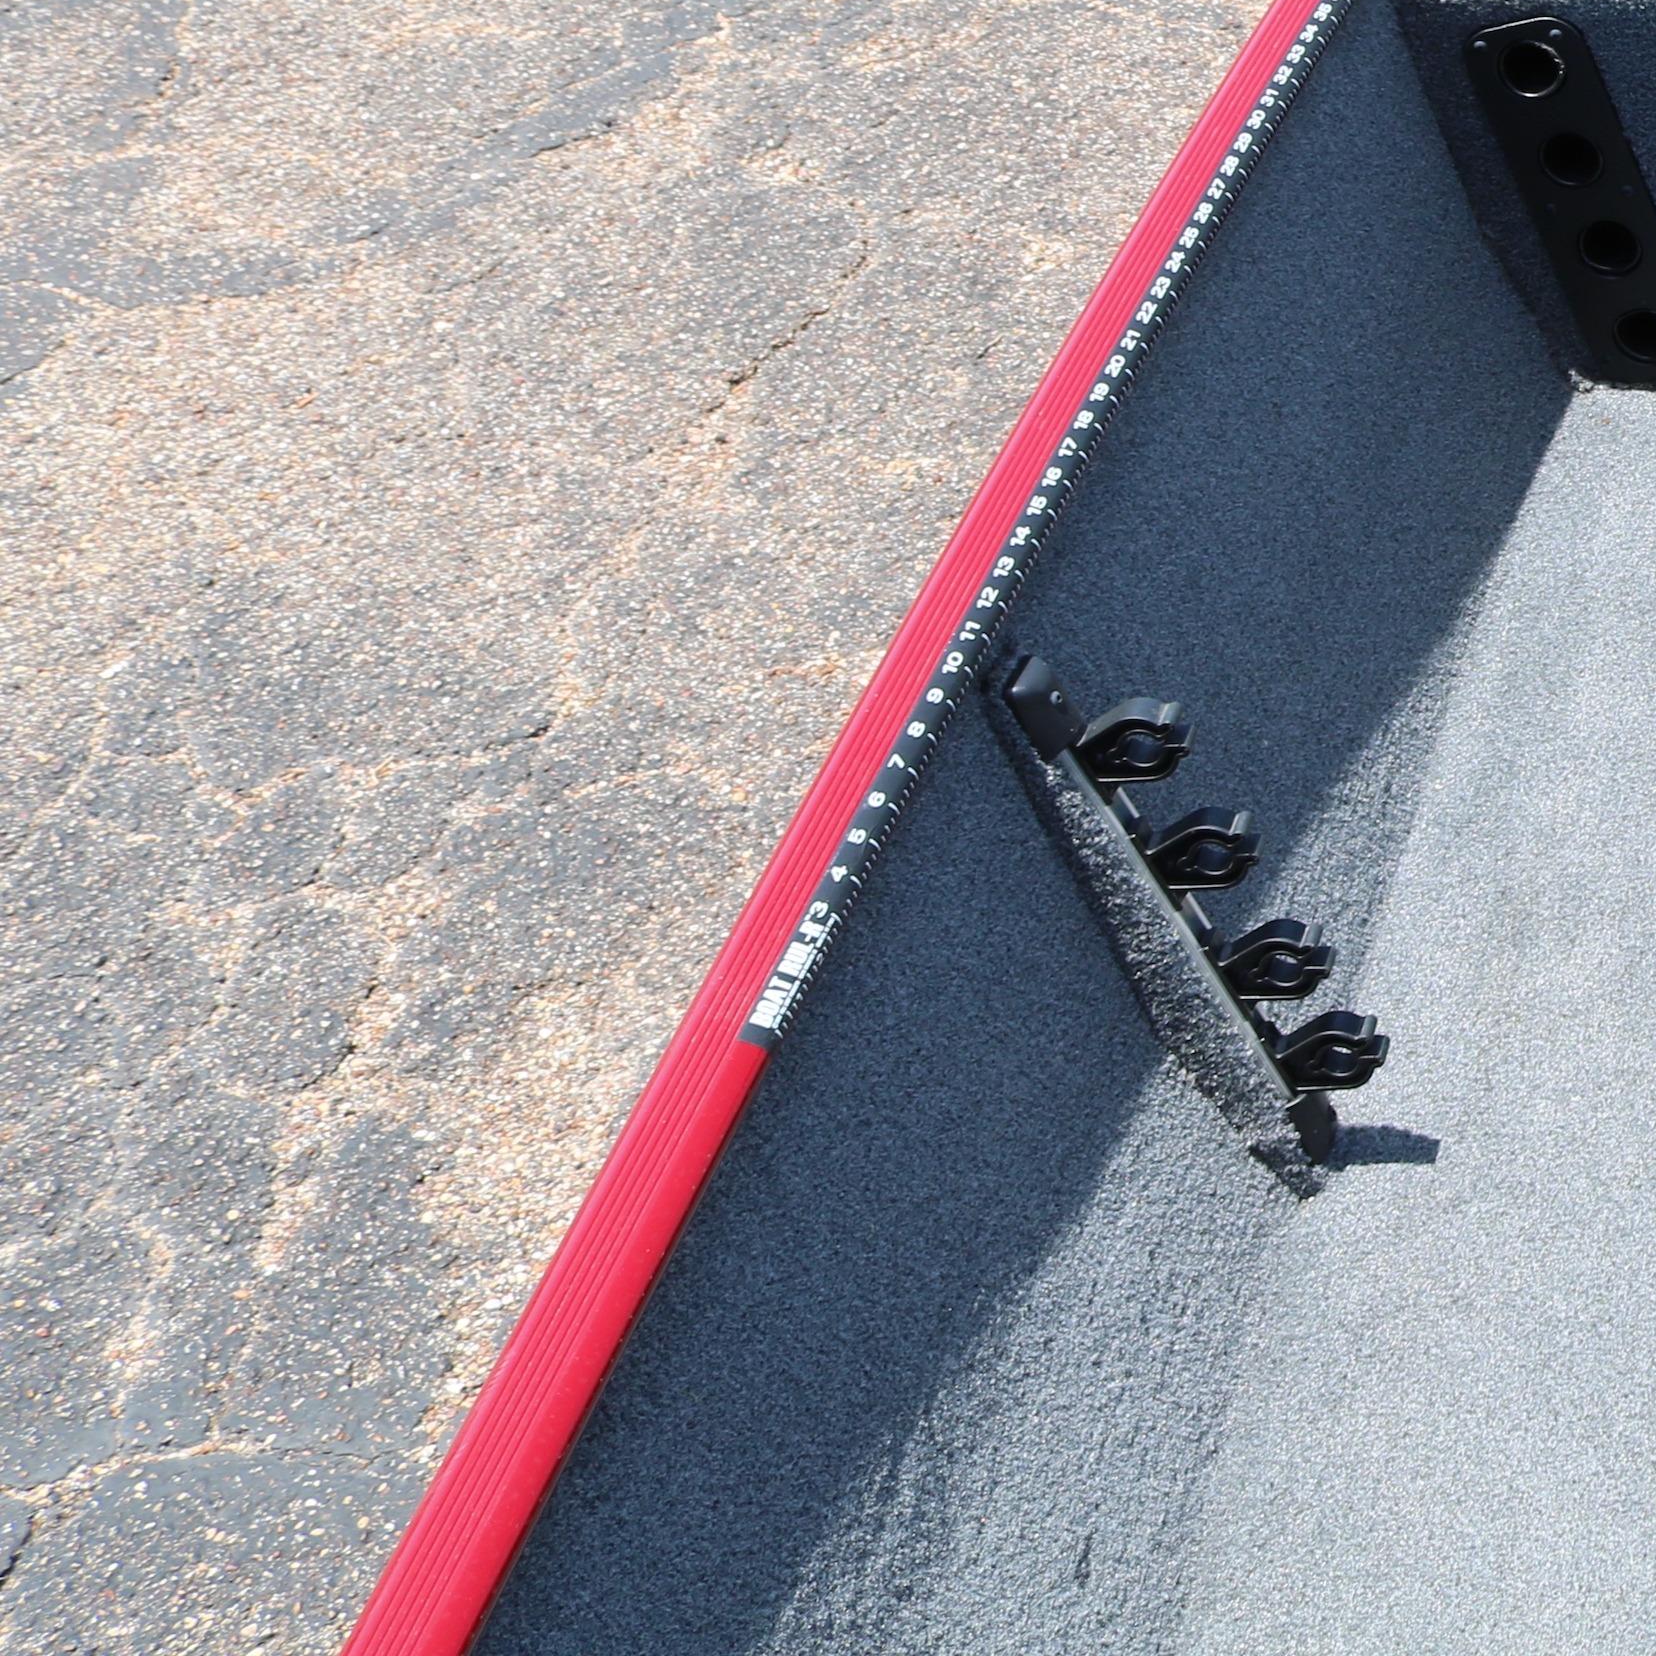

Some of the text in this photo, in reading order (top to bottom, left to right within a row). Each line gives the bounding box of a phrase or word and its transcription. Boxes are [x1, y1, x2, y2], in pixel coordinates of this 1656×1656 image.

[809, 901, 828, 918] 3
[830, 865, 848, 882] 4
[848, 828, 866, 844] 5
[868, 791, 886, 808] 6
[887, 753, 905, 768] 7
[907, 721, 925, 737] 8
[926, 688, 944, 705] 9
[942, 651, 963, 673] 10
[959, 621, 981, 641] 11
[976, 586, 999, 608] 12
[993, 556, 1014, 577] 13
[1009, 526, 1031, 546] 14
[1026, 495, 1047, 515] 15
[1041, 467, 1062, 487] 16
[1058, 437, 1077, 457] 17
[1073, 410, 1094, 429] 18
[1089, 383, 1109, 401] 19
[1104, 354, 1125, 377] 20
[1120, 329, 1141, 351] 21
[1136, 301, 1155, 323] 22
[1150, 276, 1170, 299] 23
[1164, 251, 1185, 273] 24
[1178, 226, 1199, 248] 25
[1193, 202, 1213, 224] 26
[1206, 178, 1225, 199] 27
[1219, 155, 1239, 176] 28
[1232, 132, 1252, 153] 29
[1246, 109, 1266, 129] 30
[1259, 88, 1279, 107] 31
[1273, 65, 1291, 85] 32
[1286, 44, 1305, 63] 33
[1299, 24, 1318, 42] 34
[1313, 3, 1332, 21] 35
[748, 976, 793, 1029] BOAT
